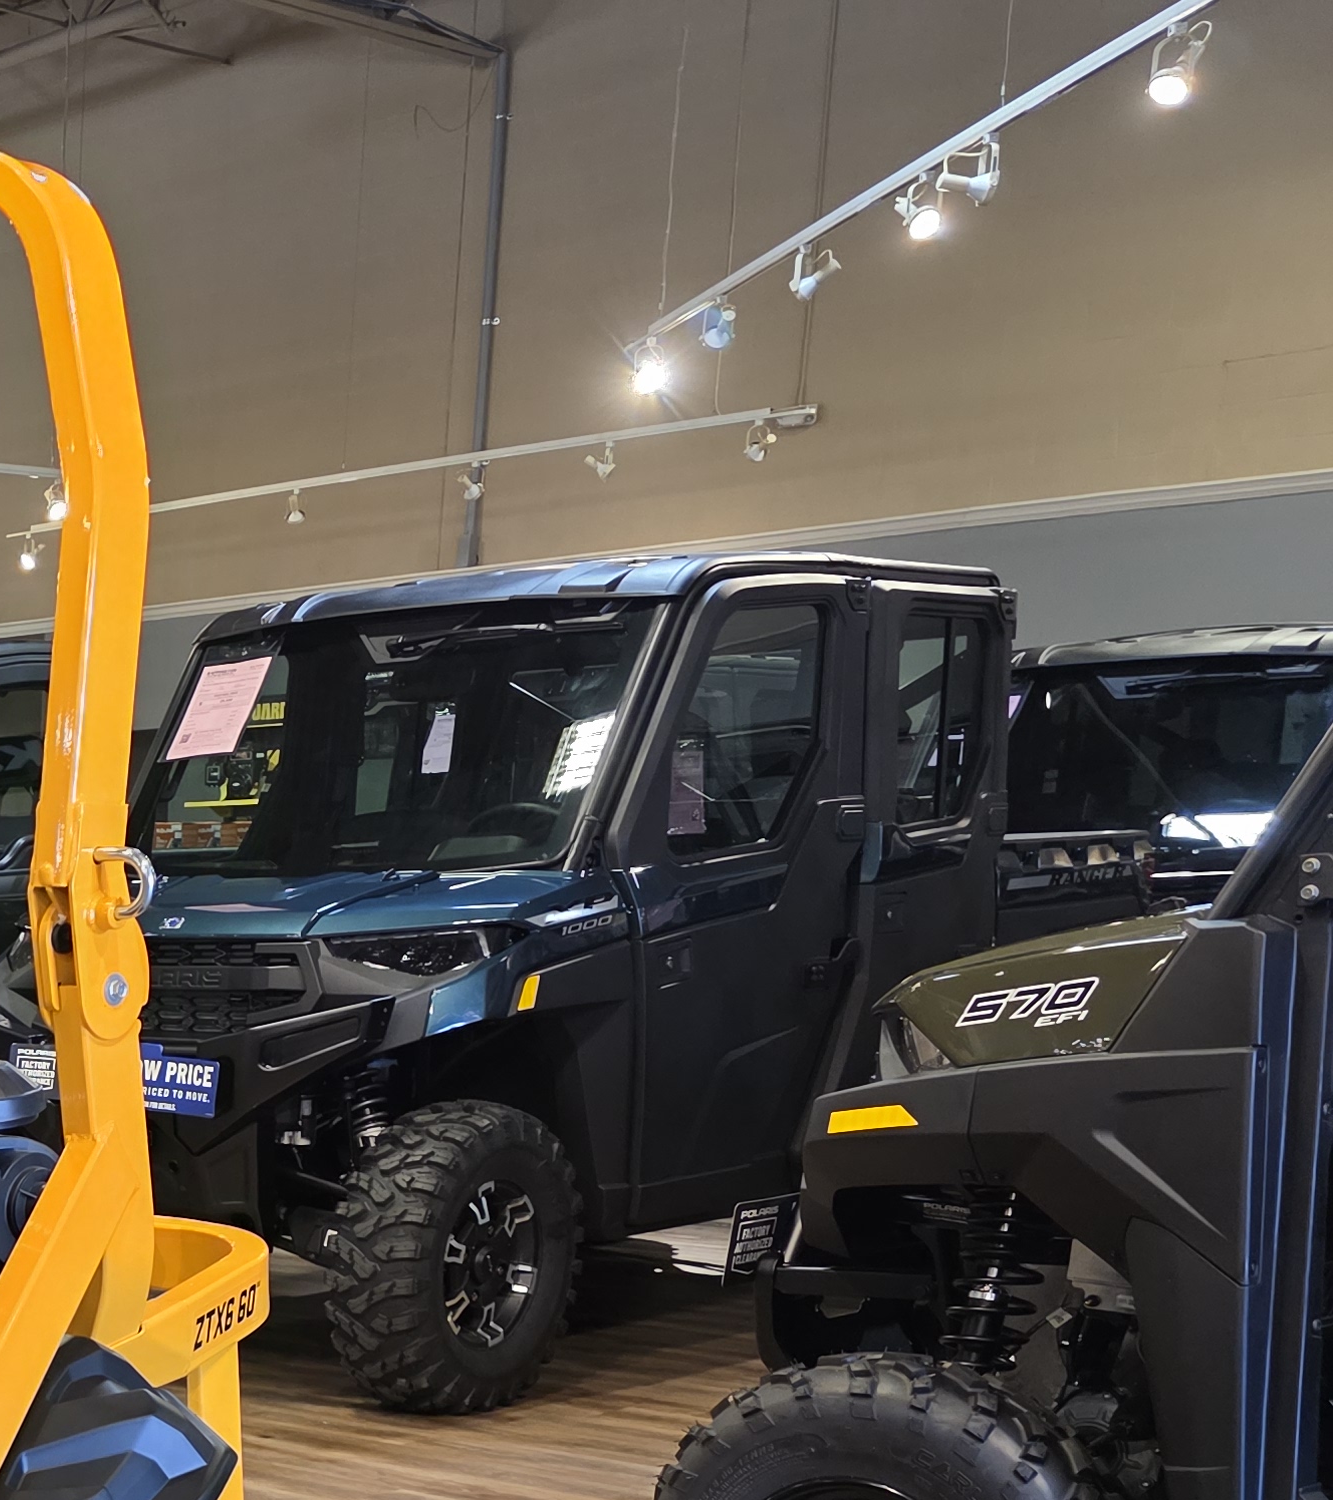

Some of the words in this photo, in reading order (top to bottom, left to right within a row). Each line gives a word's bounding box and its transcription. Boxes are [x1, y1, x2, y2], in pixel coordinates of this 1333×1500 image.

[562, 915, 613, 936] 1000
[955, 976, 1100, 1029] 570
[1034, 1009, 1088, 1028] EFI
[21, 1060, 51, 1070] FACTORY
[165, 1061, 214, 1089] PRICE
[143, 1086, 170, 1099] RICED
[172, 1089, 184, 1100] TO
[185, 1091, 211, 1104] MOVE.
[740, 1205, 780, 1220] POLARIS
[741, 1224, 771, 1241] FACTORY
[193, 1297, 236, 1352] ZTX6
